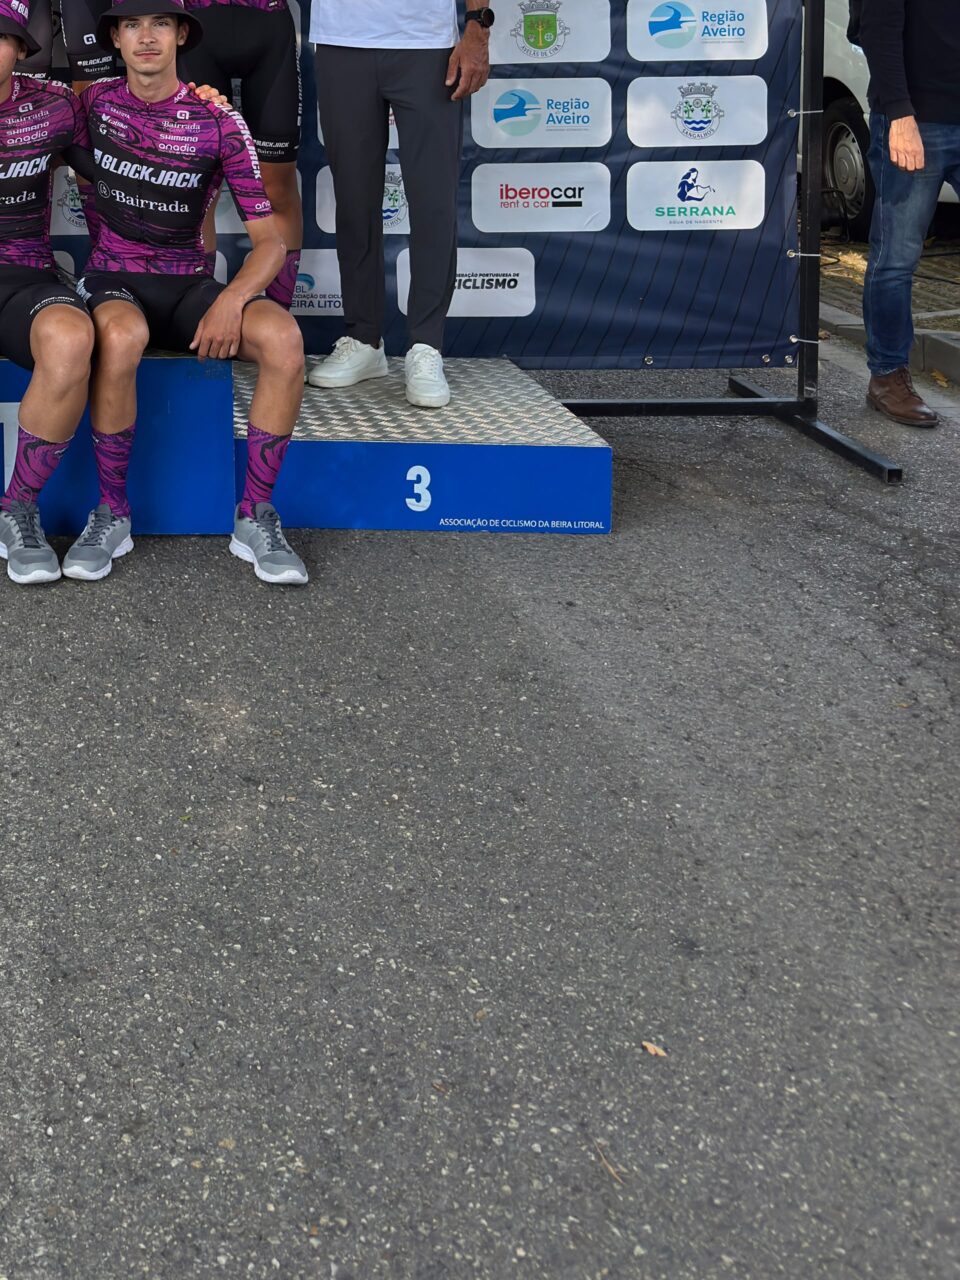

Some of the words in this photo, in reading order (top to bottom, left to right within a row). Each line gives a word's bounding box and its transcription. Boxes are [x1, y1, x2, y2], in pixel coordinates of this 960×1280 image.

[701, 10, 745, 26] Região
[701, 25, 746, 37] Aveiro
[540, 49, 548, 57] DE
[549, 43, 562, 55] CIMA
[546, 98, 590, 113] Região
[546, 112, 590, 125] Aveiro
[6, 120, 51, 136] SHIMANO
[161, 120, 201, 131] Bairrada
[6, 130, 49, 146] anadia
[681, 128, 715, 139] SANGALHOS
[158, 142, 197, 154] anadia
[101, 154, 203, 188] BLACKJACK
[499, 183, 585, 199] iberocar
[111, 188, 190, 214] Bairrada
[500, 199, 520, 208] rent
[522, 200, 530, 208] a
[533, 200, 550, 208] car
[655, 205, 737, 217] SERRANA
[295, 285, 307, 294] BL
[290, 300, 315, 309] EIRA
[317, 300, 342, 309] LITO
[405, 465, 432, 512] 3
[439, 518, 488, 528] ASSOCIAÇÃO
[501, 519, 537, 528] CICLISMO
[574, 521, 605, 529] LITORAL
